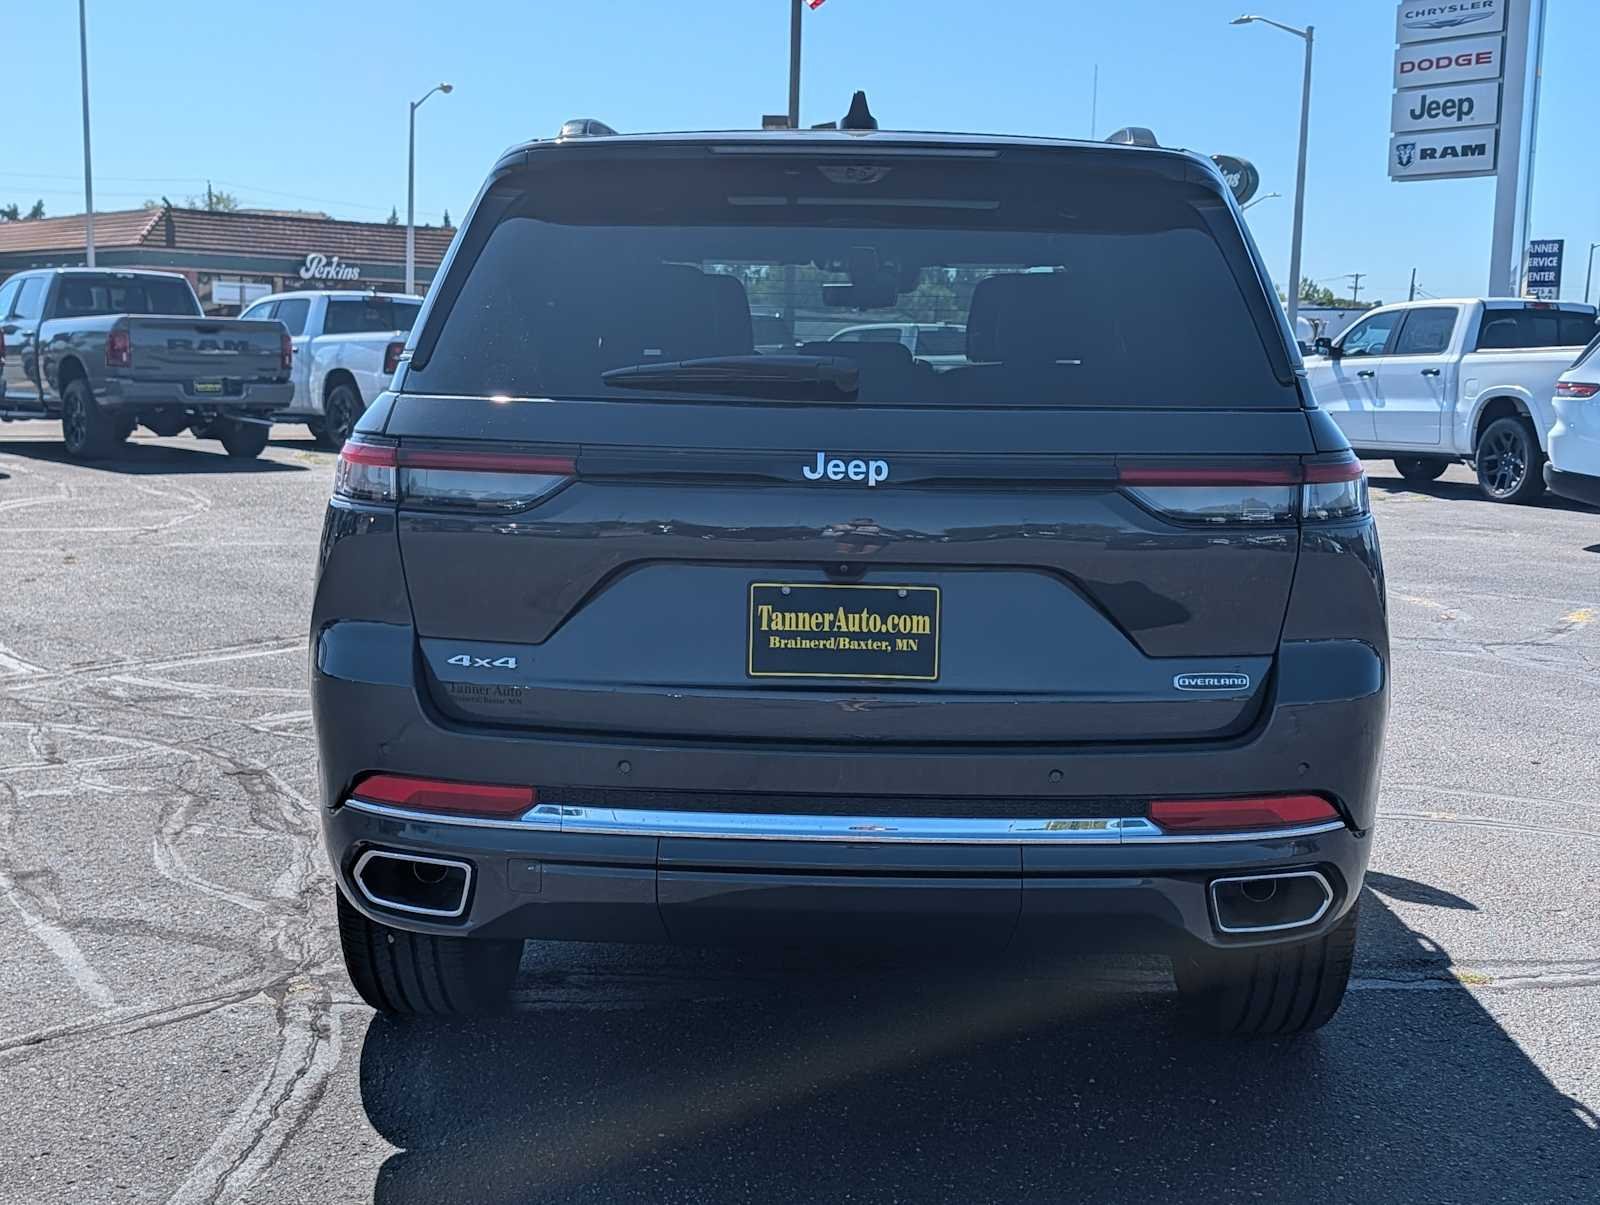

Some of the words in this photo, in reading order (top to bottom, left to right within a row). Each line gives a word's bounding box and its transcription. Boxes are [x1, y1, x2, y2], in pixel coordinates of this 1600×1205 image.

[1404, 0, 1494, 19] CHRYSLER
[1399, 51, 1493, 74] DODGE
[1409, 94, 1474, 122] Jeep
[1419, 143, 1487, 160] RAM
[1528, 243, 1559, 253] ANNER
[299, 253, 360, 280] Perkins
[1528, 257, 1558, 266] ERVICE
[1528, 272, 1556, 281] ENTER
[167, 338, 249, 351] RAM
[802, 452, 889, 487] Jeep
[757, 605, 931, 635] TannerAuto.com
[768, 636, 892, 653] Brainerd/Baxter,
[895, 639, 919, 651] MN
[447, 654, 518, 669] 4x4
[449, 681, 490, 697] Tanner
[493, 684, 523, 698] Auto
[1179, 678, 1247, 686] OVERLAND
